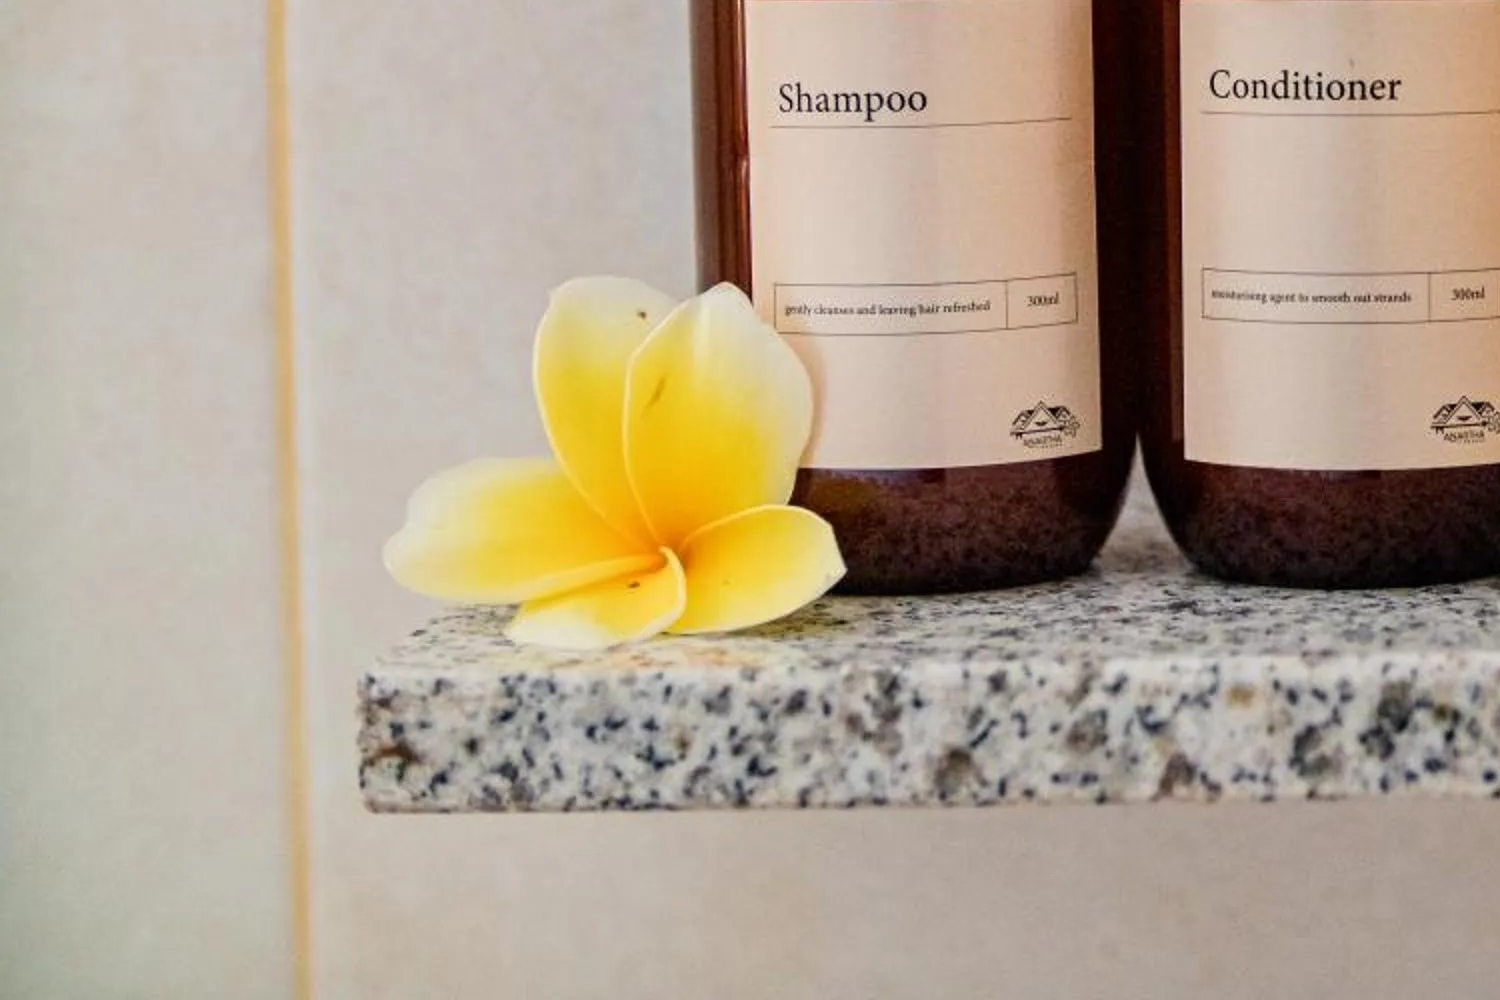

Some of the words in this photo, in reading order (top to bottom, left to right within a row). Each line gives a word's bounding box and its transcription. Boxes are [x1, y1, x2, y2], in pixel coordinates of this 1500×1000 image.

[1209, 69, 1402, 101] Conditioner
[778, 82, 928, 122] Shampoo
[857, 304, 876, 315] and
[878, 303, 917, 318] leaving
[918, 302, 940, 314] hair
[943, 299, 991, 313] refreshed
